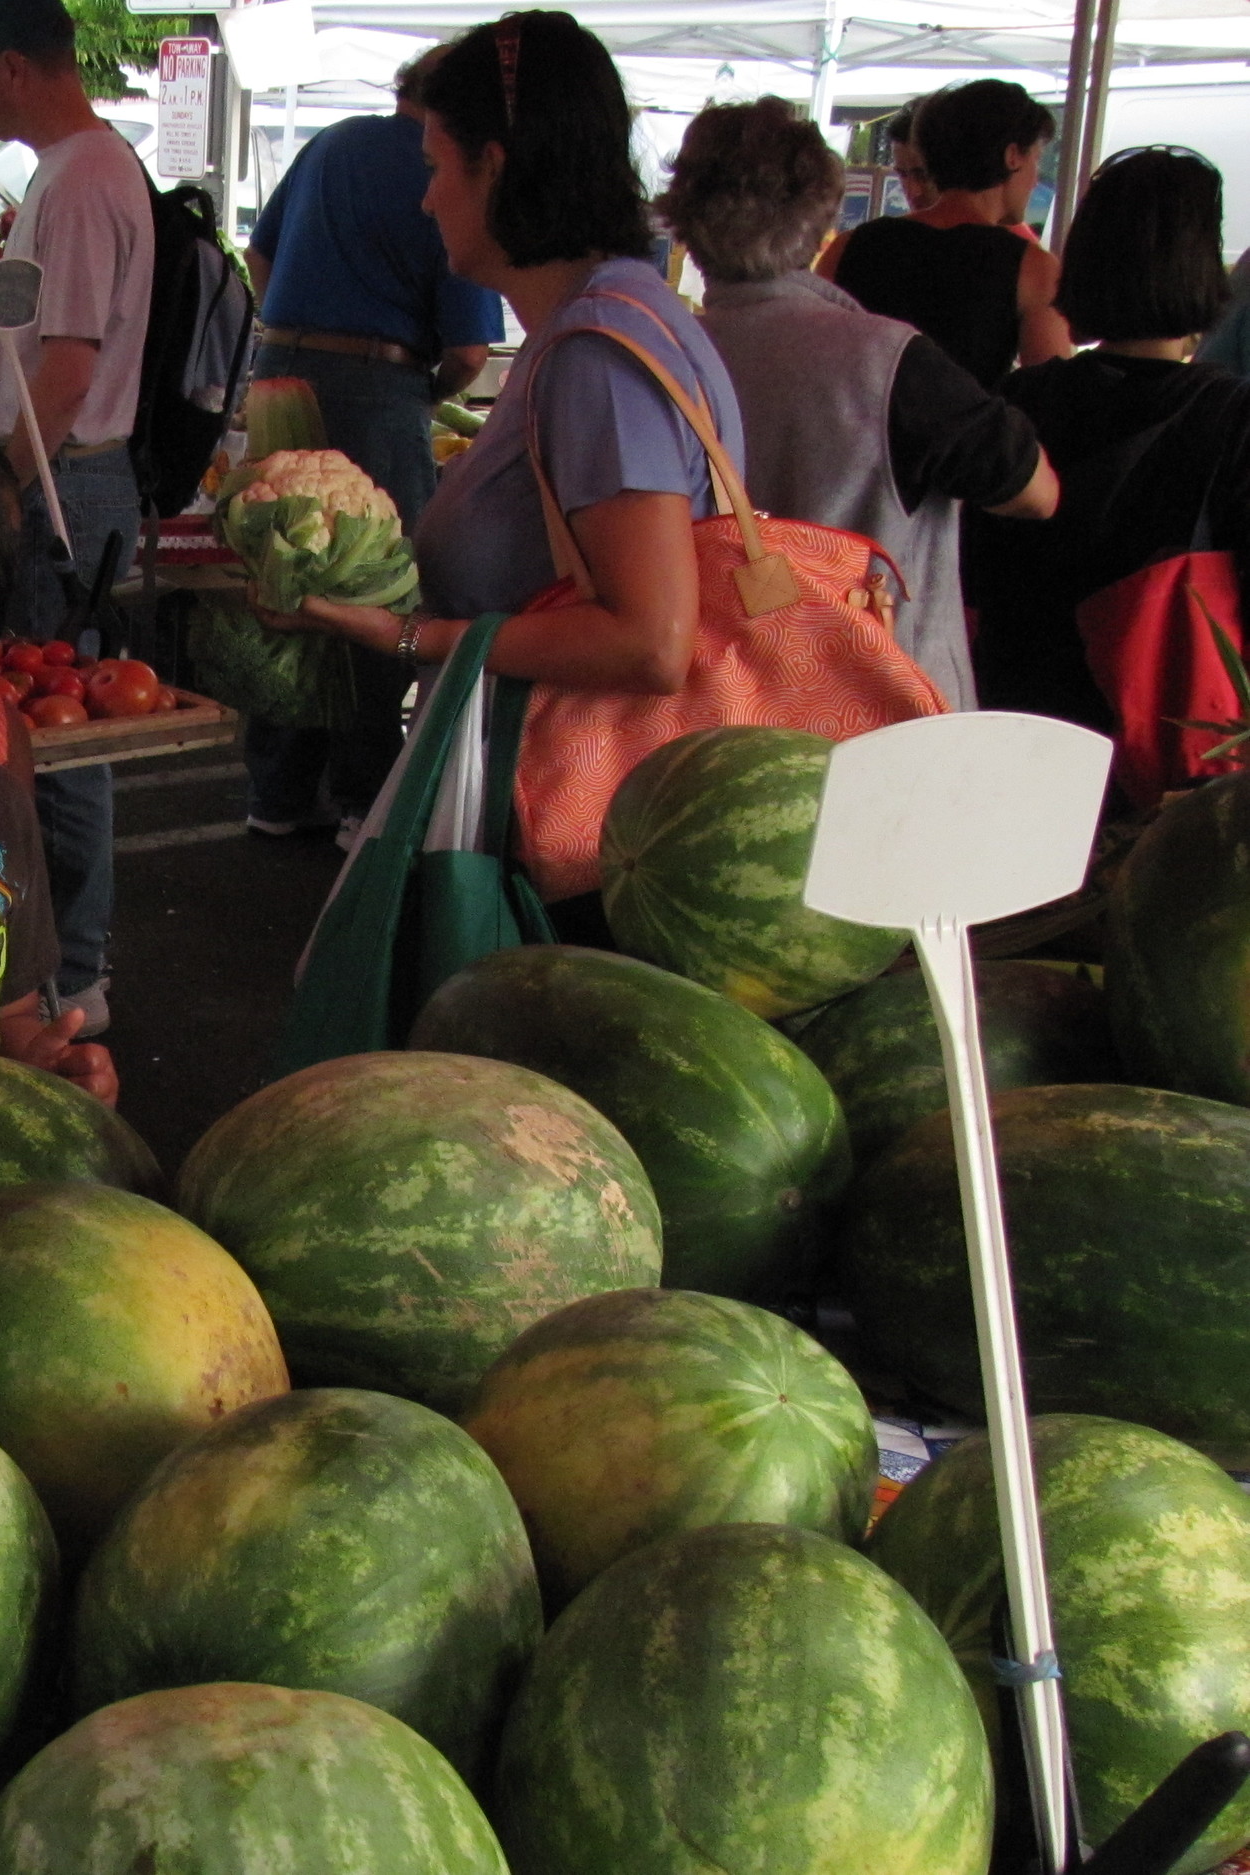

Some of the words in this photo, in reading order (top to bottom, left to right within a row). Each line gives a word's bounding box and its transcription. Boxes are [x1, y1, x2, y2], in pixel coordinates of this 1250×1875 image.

[162, 55, 174, 80] NO
[177, 57, 206, 79] PARKING
[161, 84, 167, 105] 2
